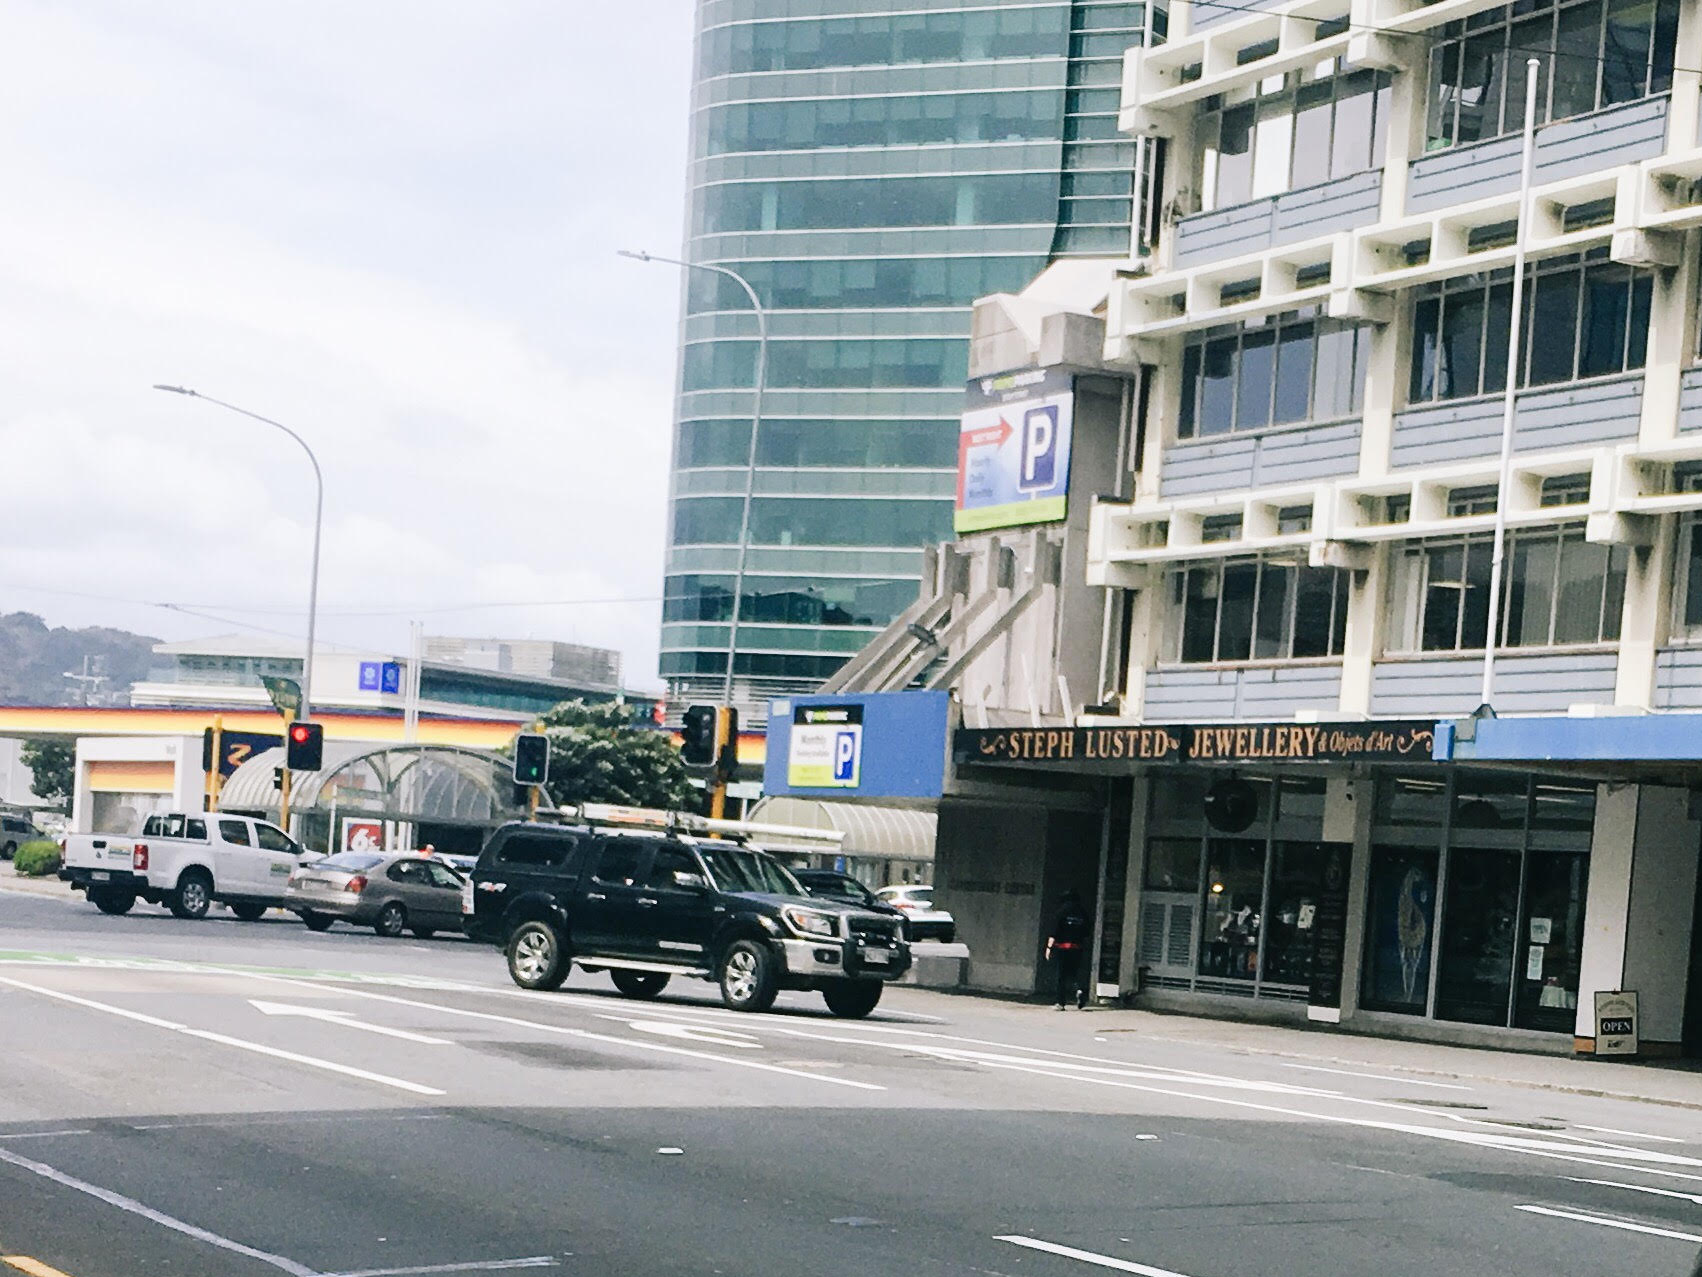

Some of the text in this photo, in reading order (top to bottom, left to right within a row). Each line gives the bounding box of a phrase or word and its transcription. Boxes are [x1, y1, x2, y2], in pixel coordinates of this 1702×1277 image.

[1025, 413, 1053, 481] P
[837, 735, 854, 776] P
[1008, 731, 1075, 758] STEPH
[1086, 729, 1168, 758] LUSTED
[1189, 727, 1320, 758] JEWELLERY
[1329, 730, 1363, 757] Objets
[1602, 1021, 1630, 1032] OPEN
